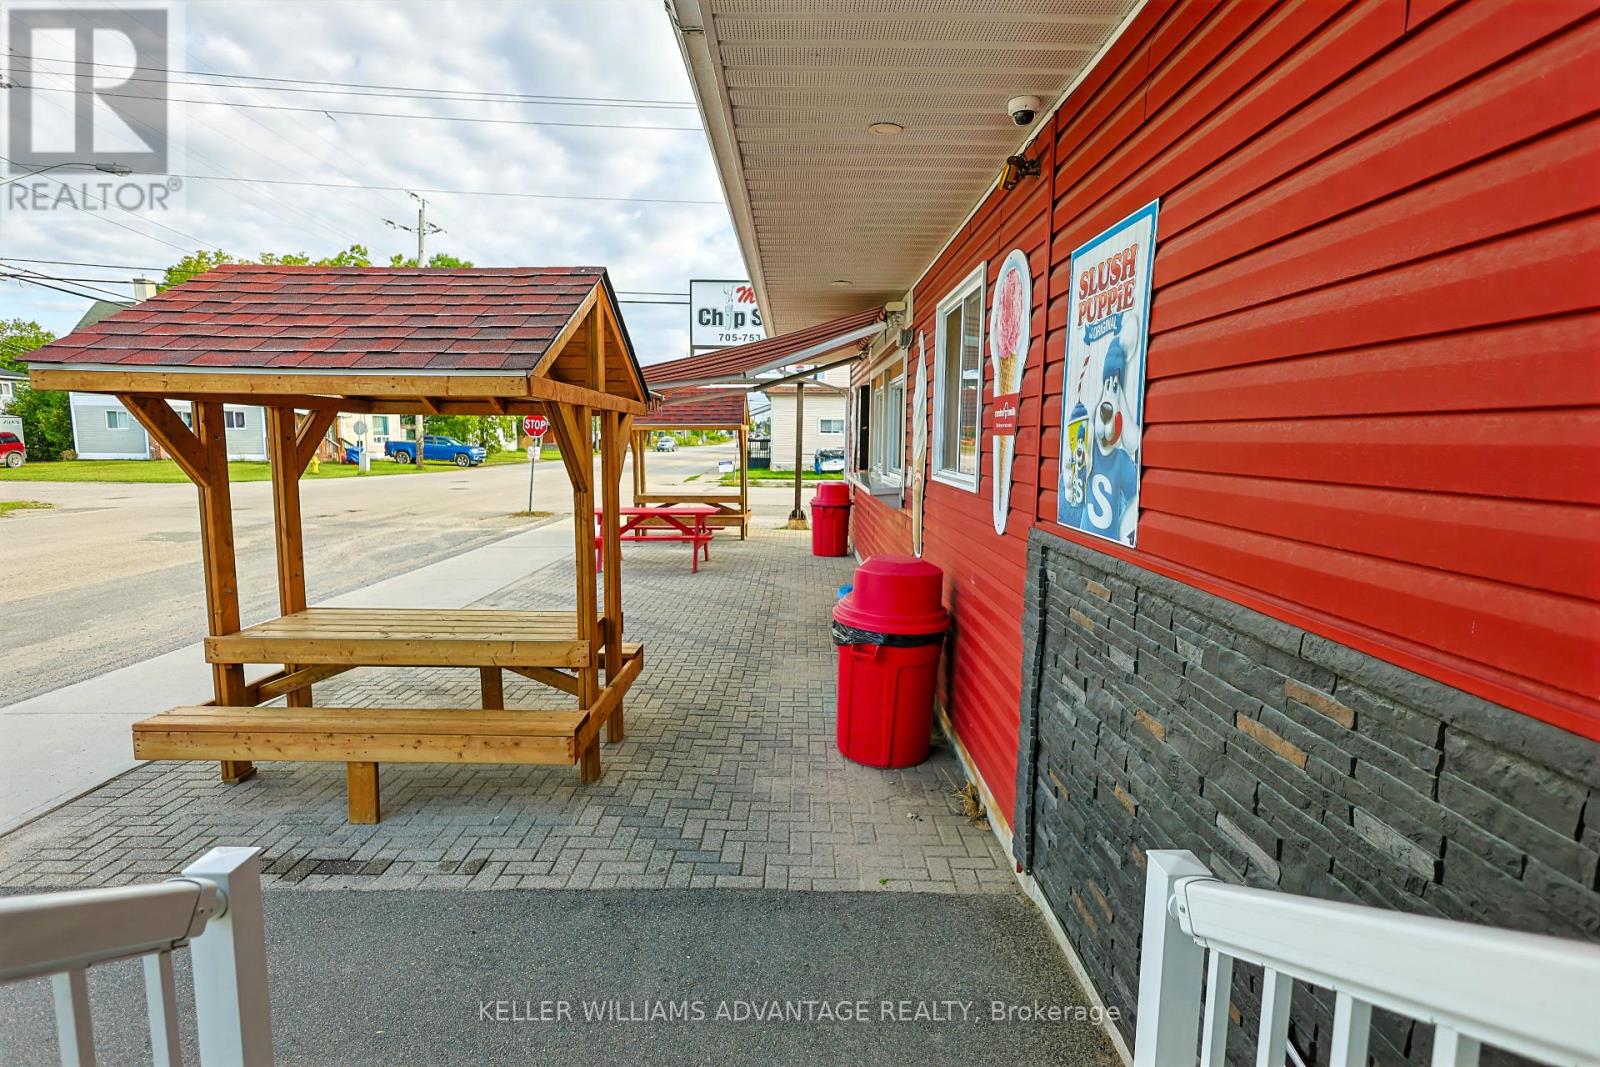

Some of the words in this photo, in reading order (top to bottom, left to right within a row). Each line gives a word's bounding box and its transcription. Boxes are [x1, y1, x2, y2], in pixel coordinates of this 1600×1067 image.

[1079, 243, 1138, 301] SLUSH
[752, 308, 763, 326] S
[525, 419, 546, 429] STOP
[1087, 473, 1113, 529] S
